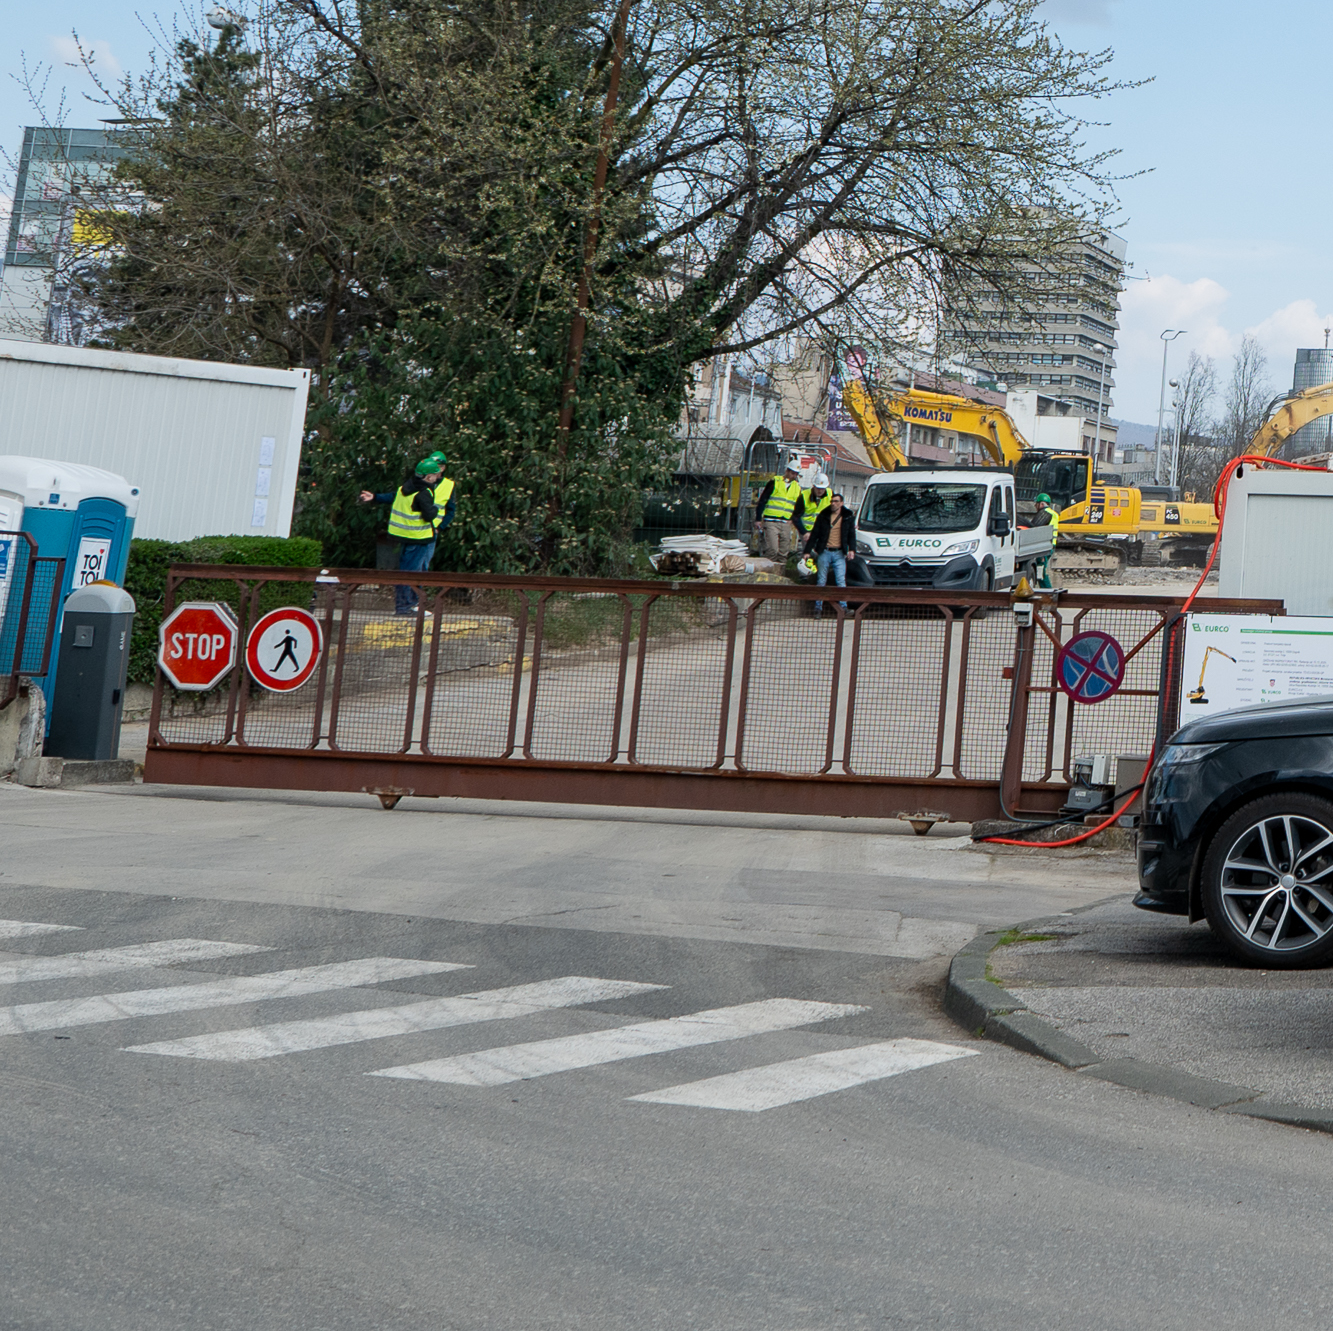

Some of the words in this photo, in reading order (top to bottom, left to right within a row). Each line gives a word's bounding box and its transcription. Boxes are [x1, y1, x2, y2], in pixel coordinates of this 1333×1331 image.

[903, 406, 953, 423] KOMATSU
[898, 538, 942, 548] EURCO
[1205, 625, 1230, 633] EURCO
[170, 632, 225, 660] STOP
